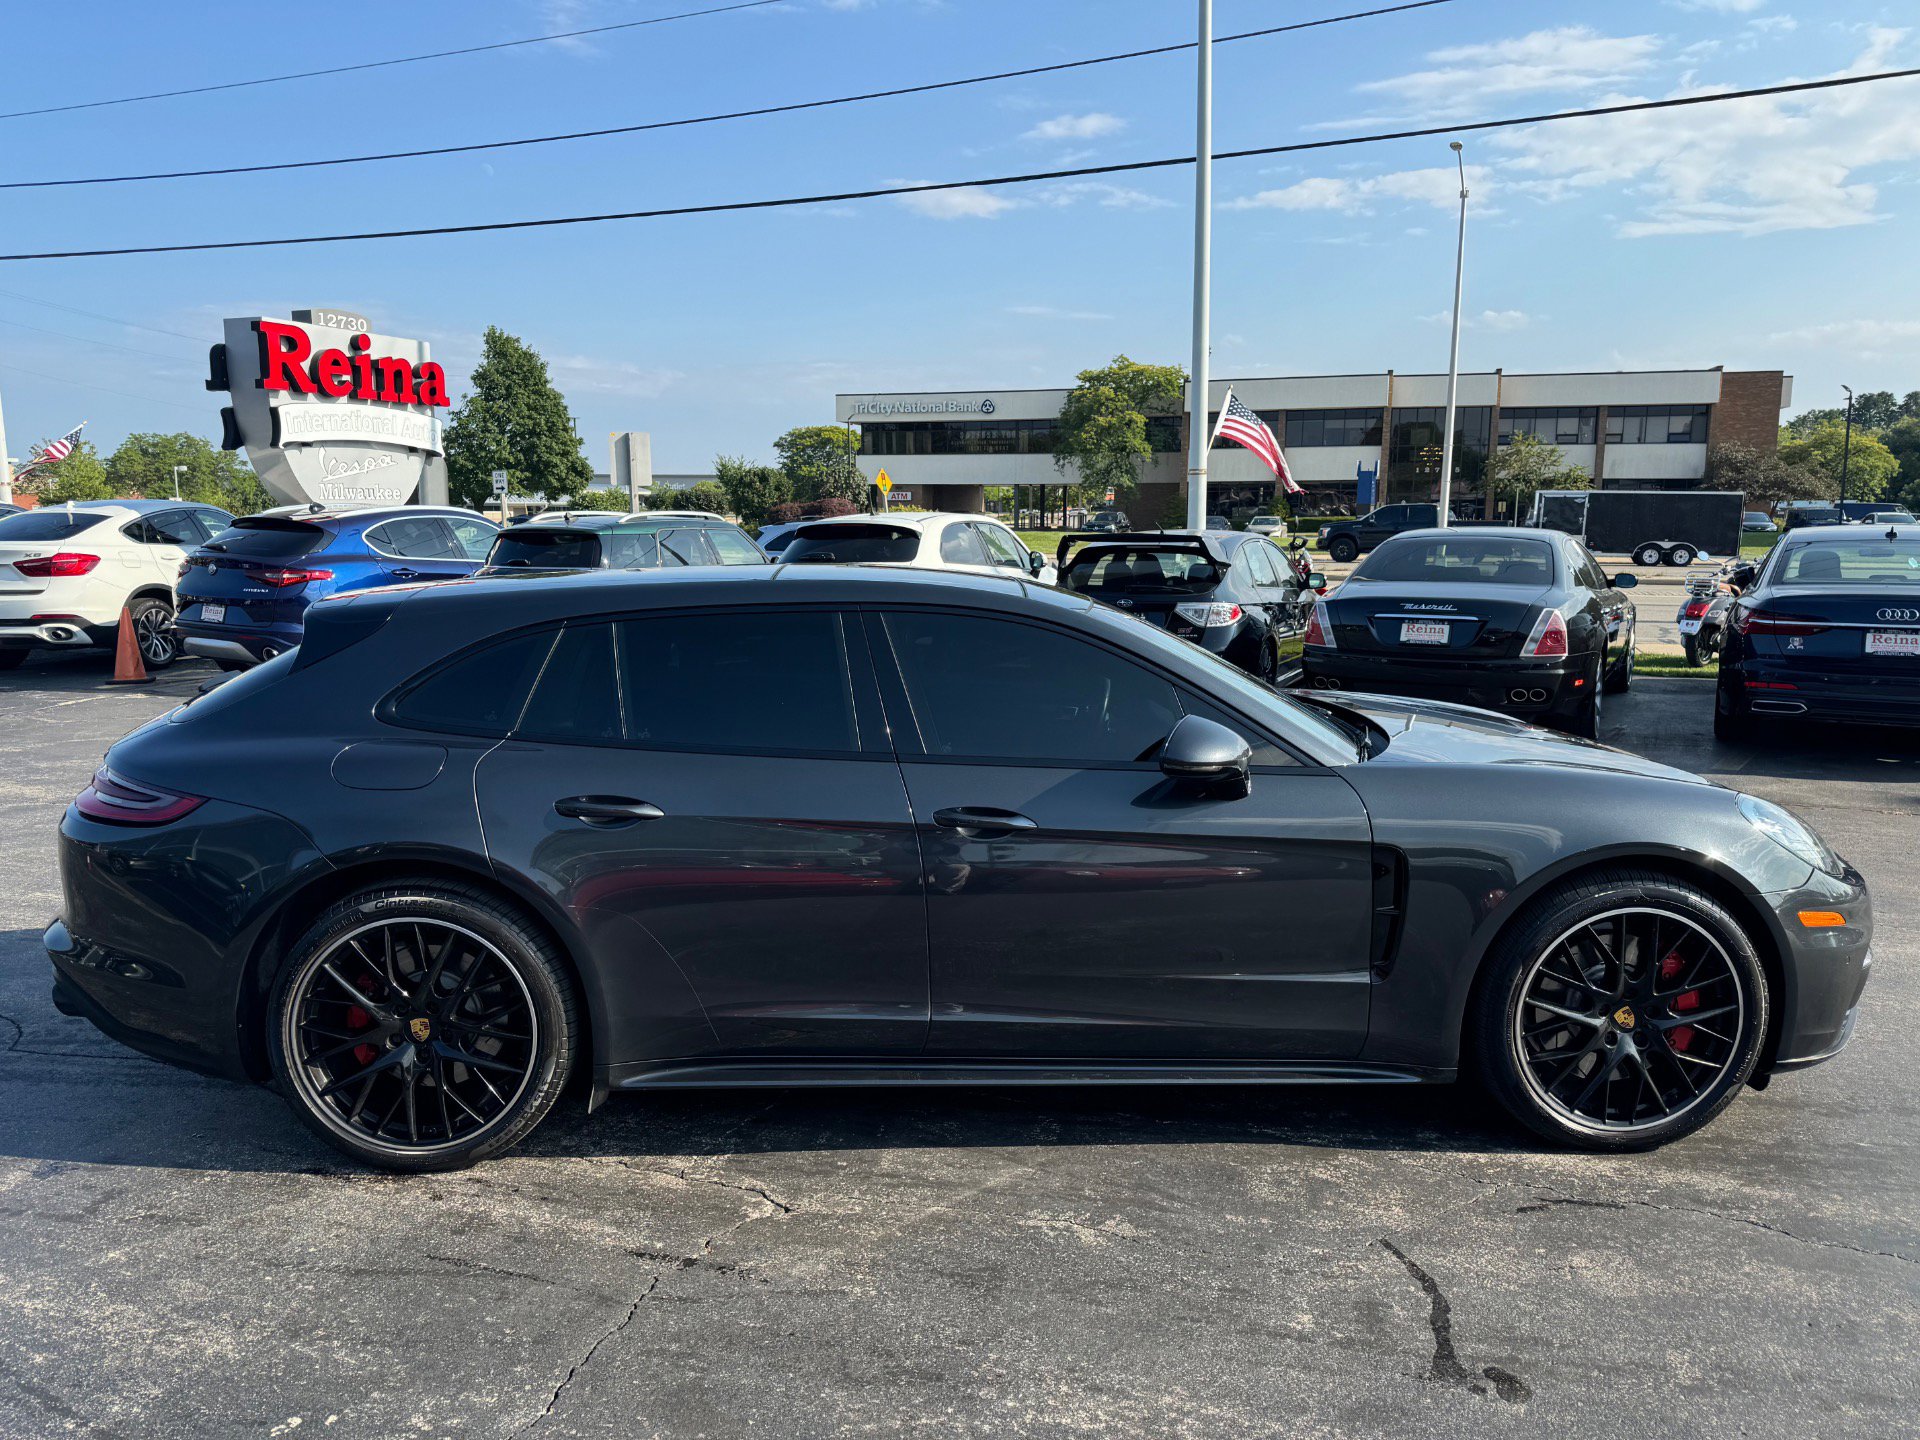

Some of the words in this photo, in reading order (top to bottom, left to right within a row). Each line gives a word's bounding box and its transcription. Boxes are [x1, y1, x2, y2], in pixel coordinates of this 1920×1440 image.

[318, 312, 367, 332] 12730
[256, 321, 450, 407] Reina
[894, 400, 946, 413] National
[948, 400, 980, 413] Bank
[285, 409, 398, 436] International
[401, 417, 439, 445] Auto
[318, 446, 399, 482] Vespa
[319, 483, 402, 500] Milwaukee
[204, 606, 223, 614] Reina
[1406, 624, 1445, 634] Reina
[1872, 634, 1919, 644] Reina
